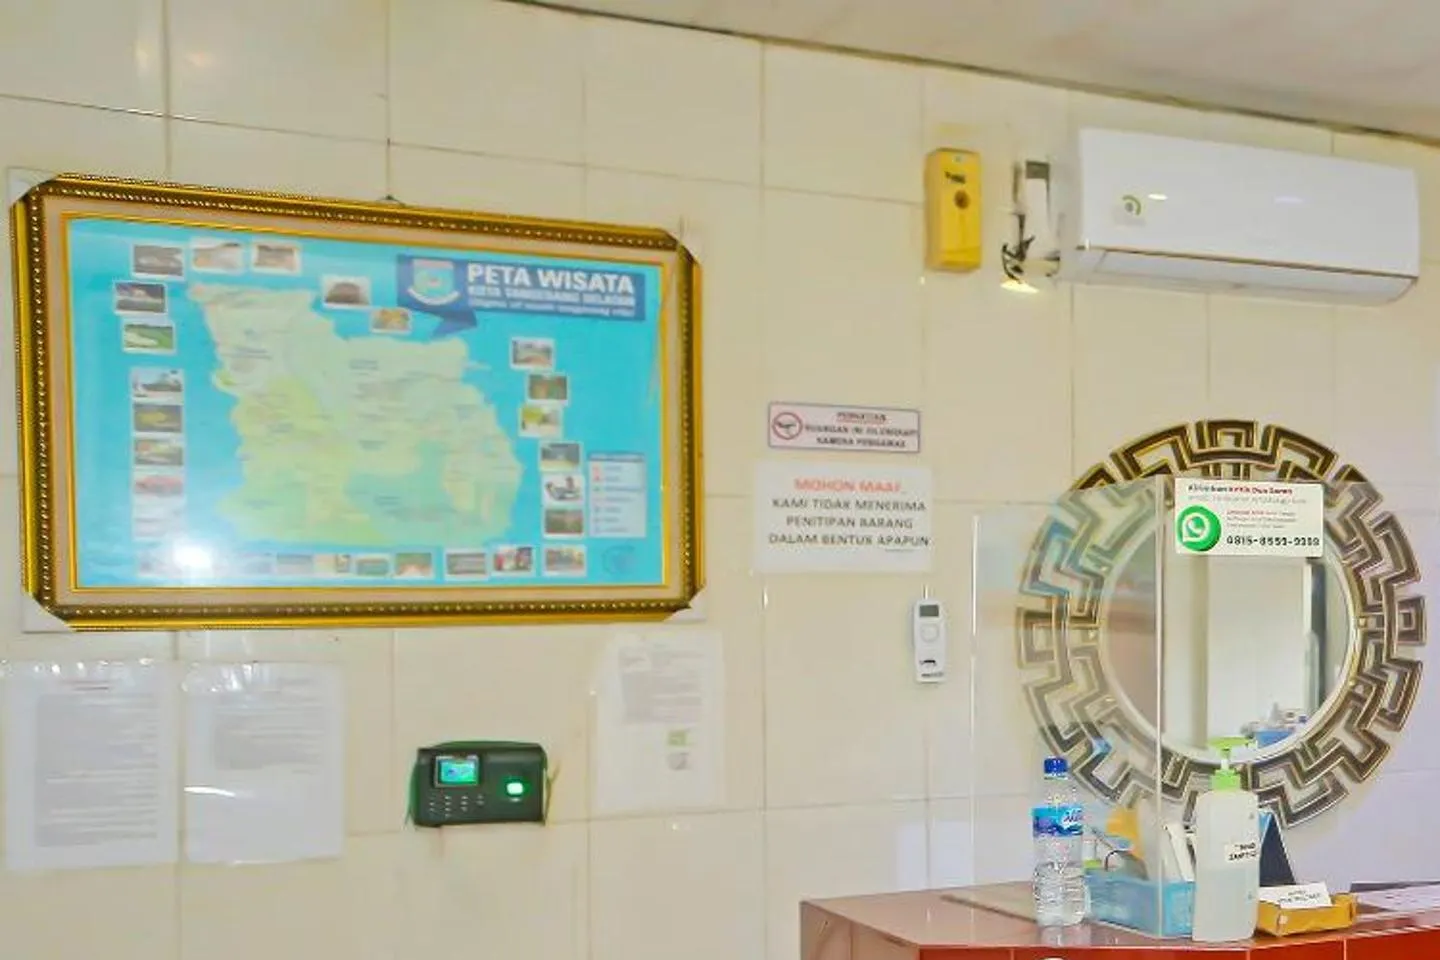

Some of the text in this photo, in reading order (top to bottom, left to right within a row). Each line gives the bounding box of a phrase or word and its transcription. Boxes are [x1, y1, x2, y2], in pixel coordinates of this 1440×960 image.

[467, 263, 635, 294] PETA WISATA
[794, 478, 901, 493] MOHON MAAF
[772, 499, 926, 512] KAMI TIDAK MENERIMA
[786, 517, 913, 529] PENITIPAN BARANG
[769, 533, 929, 547] DALAM BENTUK APAPUN
